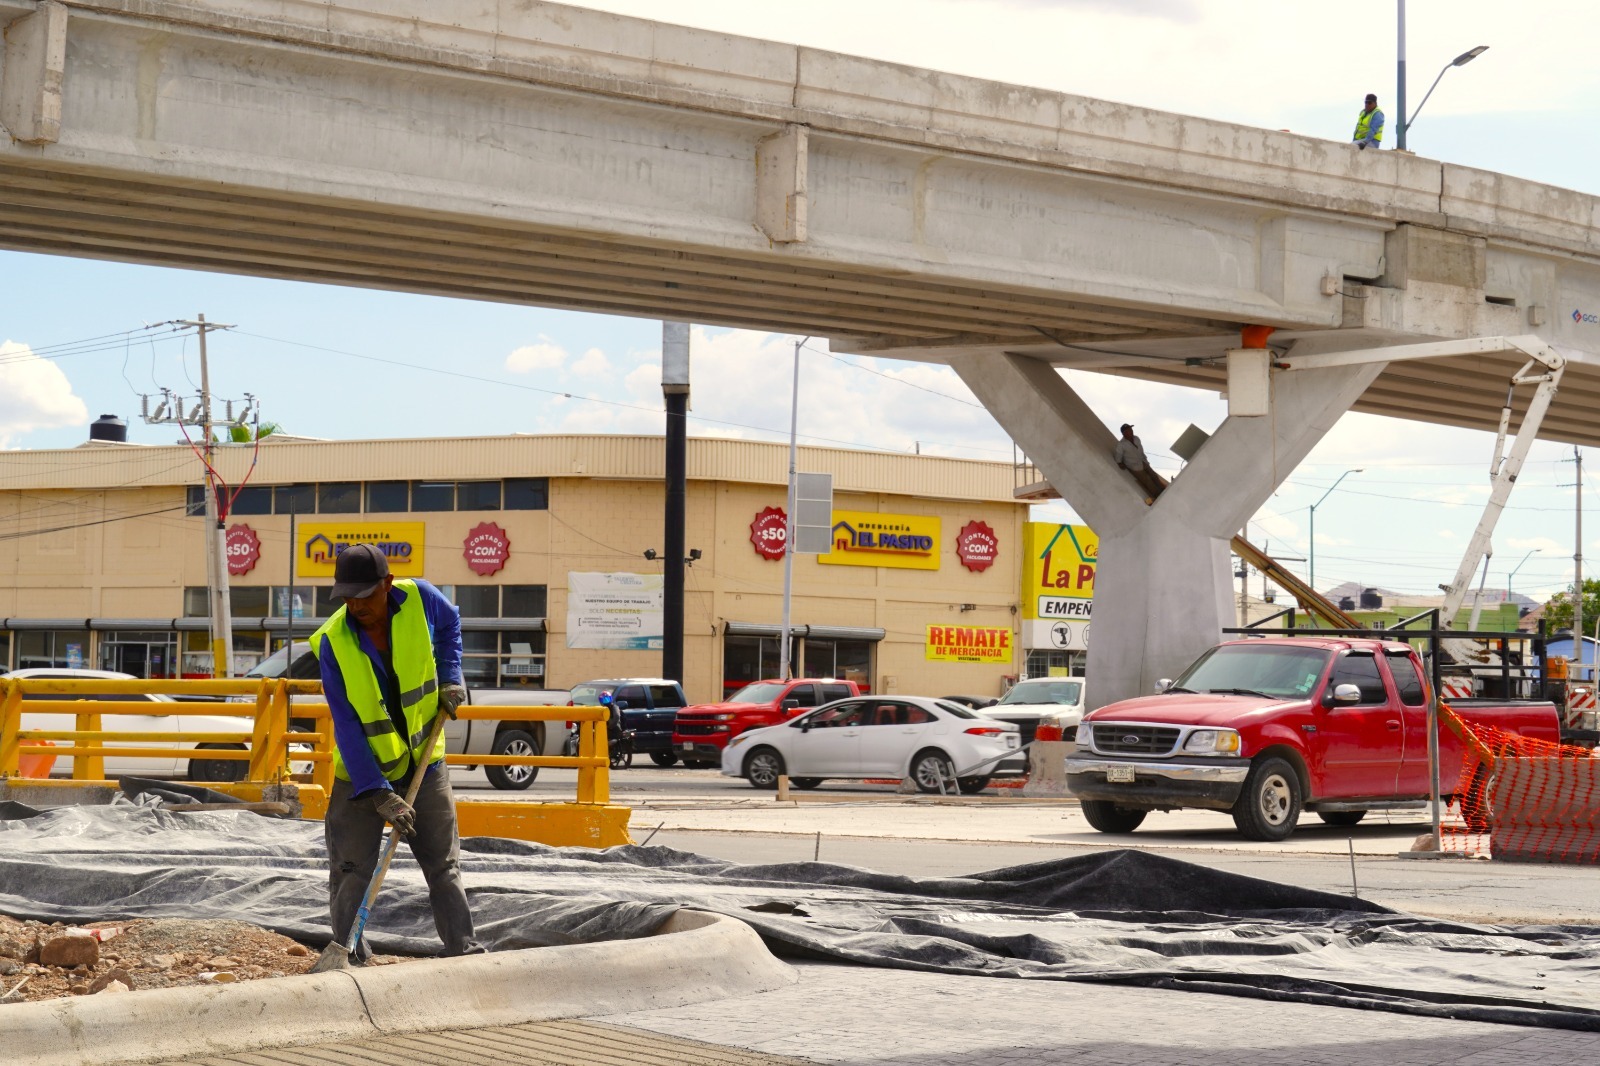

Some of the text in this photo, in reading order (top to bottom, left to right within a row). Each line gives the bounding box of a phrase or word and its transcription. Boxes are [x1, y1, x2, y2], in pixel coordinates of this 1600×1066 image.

[1582, 314, 1598, 324] GCC
[226, 531, 244, 544] REDITO
[762, 528, 786, 540] $50
[964, 532, 994, 546] CONTADO
[470, 534, 502, 548] CONTADO
[858, 532, 933, 550] EL PASITO
[227, 543, 250, 556] $50
[474, 546, 496, 556] CON
[968, 544, 988, 554] CON
[1042, 550, 1070, 588] La
[1044, 600, 1092, 616] EMPEÑ
[930, 626, 1009, 648] REMATE
[936, 646, 1002, 657] DE MERCANCIA
